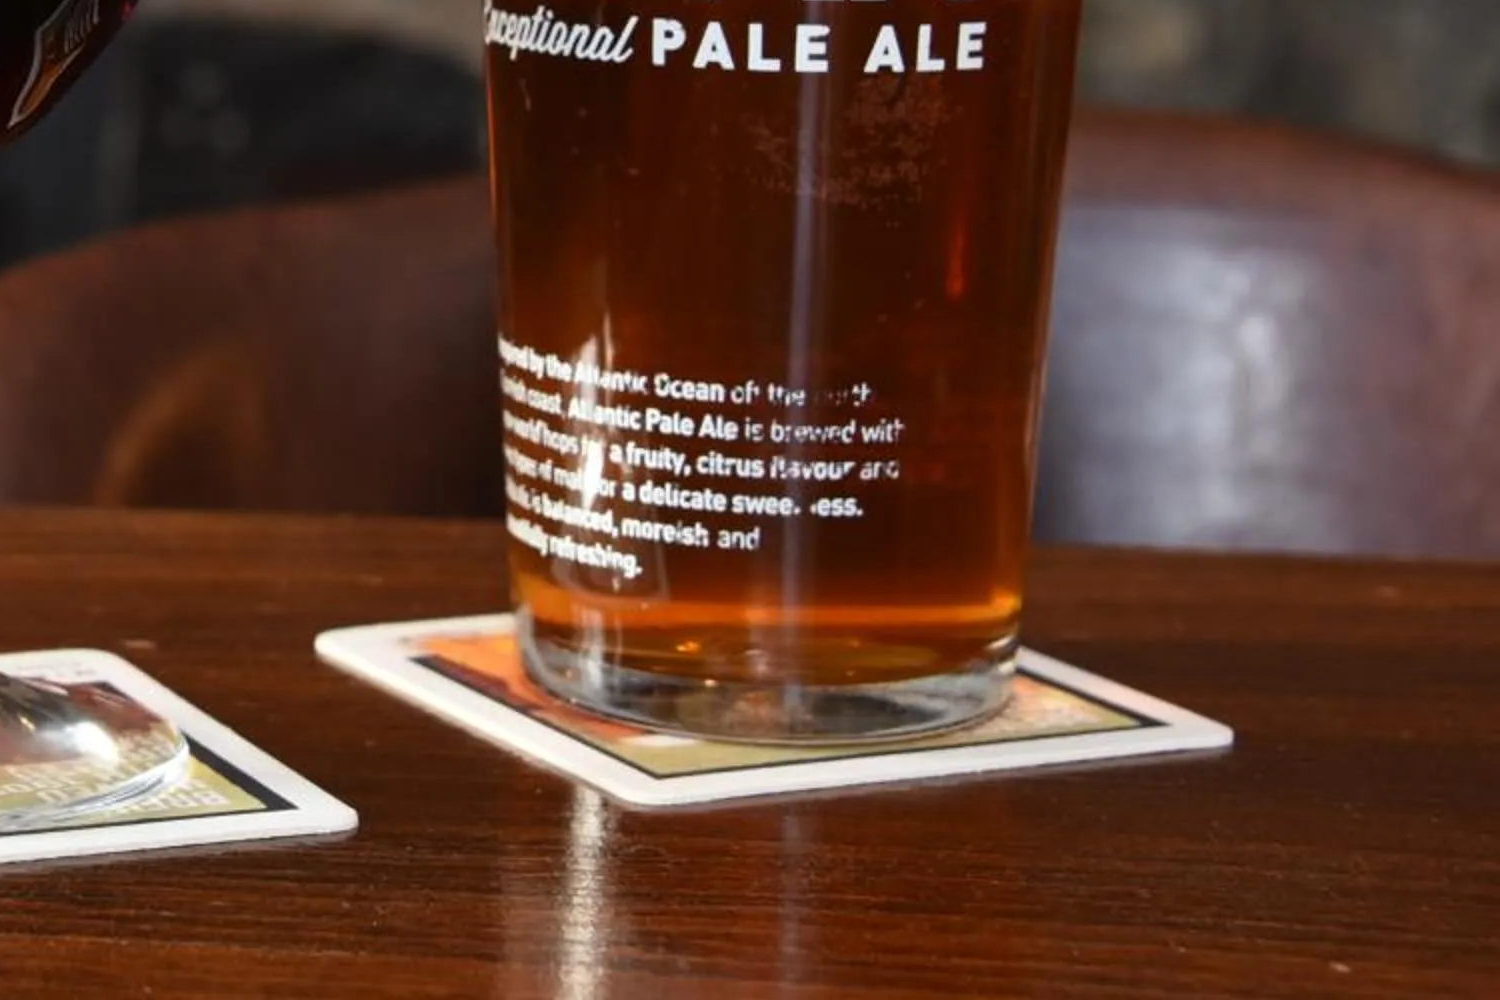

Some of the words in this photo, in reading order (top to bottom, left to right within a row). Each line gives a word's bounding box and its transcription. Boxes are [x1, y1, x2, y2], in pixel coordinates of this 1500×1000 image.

[652, 18, 831, 74] PALE
[864, 21, 987, 73] ALE
[654, 373, 726, 402] Ocean
[568, 396, 642, 430] Atlantic
[645, 407, 695, 436] Pale
[699, 414, 738, 441] Ale
[745, 417, 764, 442] is
[609, 443, 623, 462] a
[626, 441, 691, 476] fruity,
[696, 451, 765, 478] citrus
[622, 482, 635, 501] a
[639, 480, 727, 512] delicate
[731, 494, 863, 517] sweeess.
[621, 517, 709, 548] moreish
[718, 526, 761, 550] and
